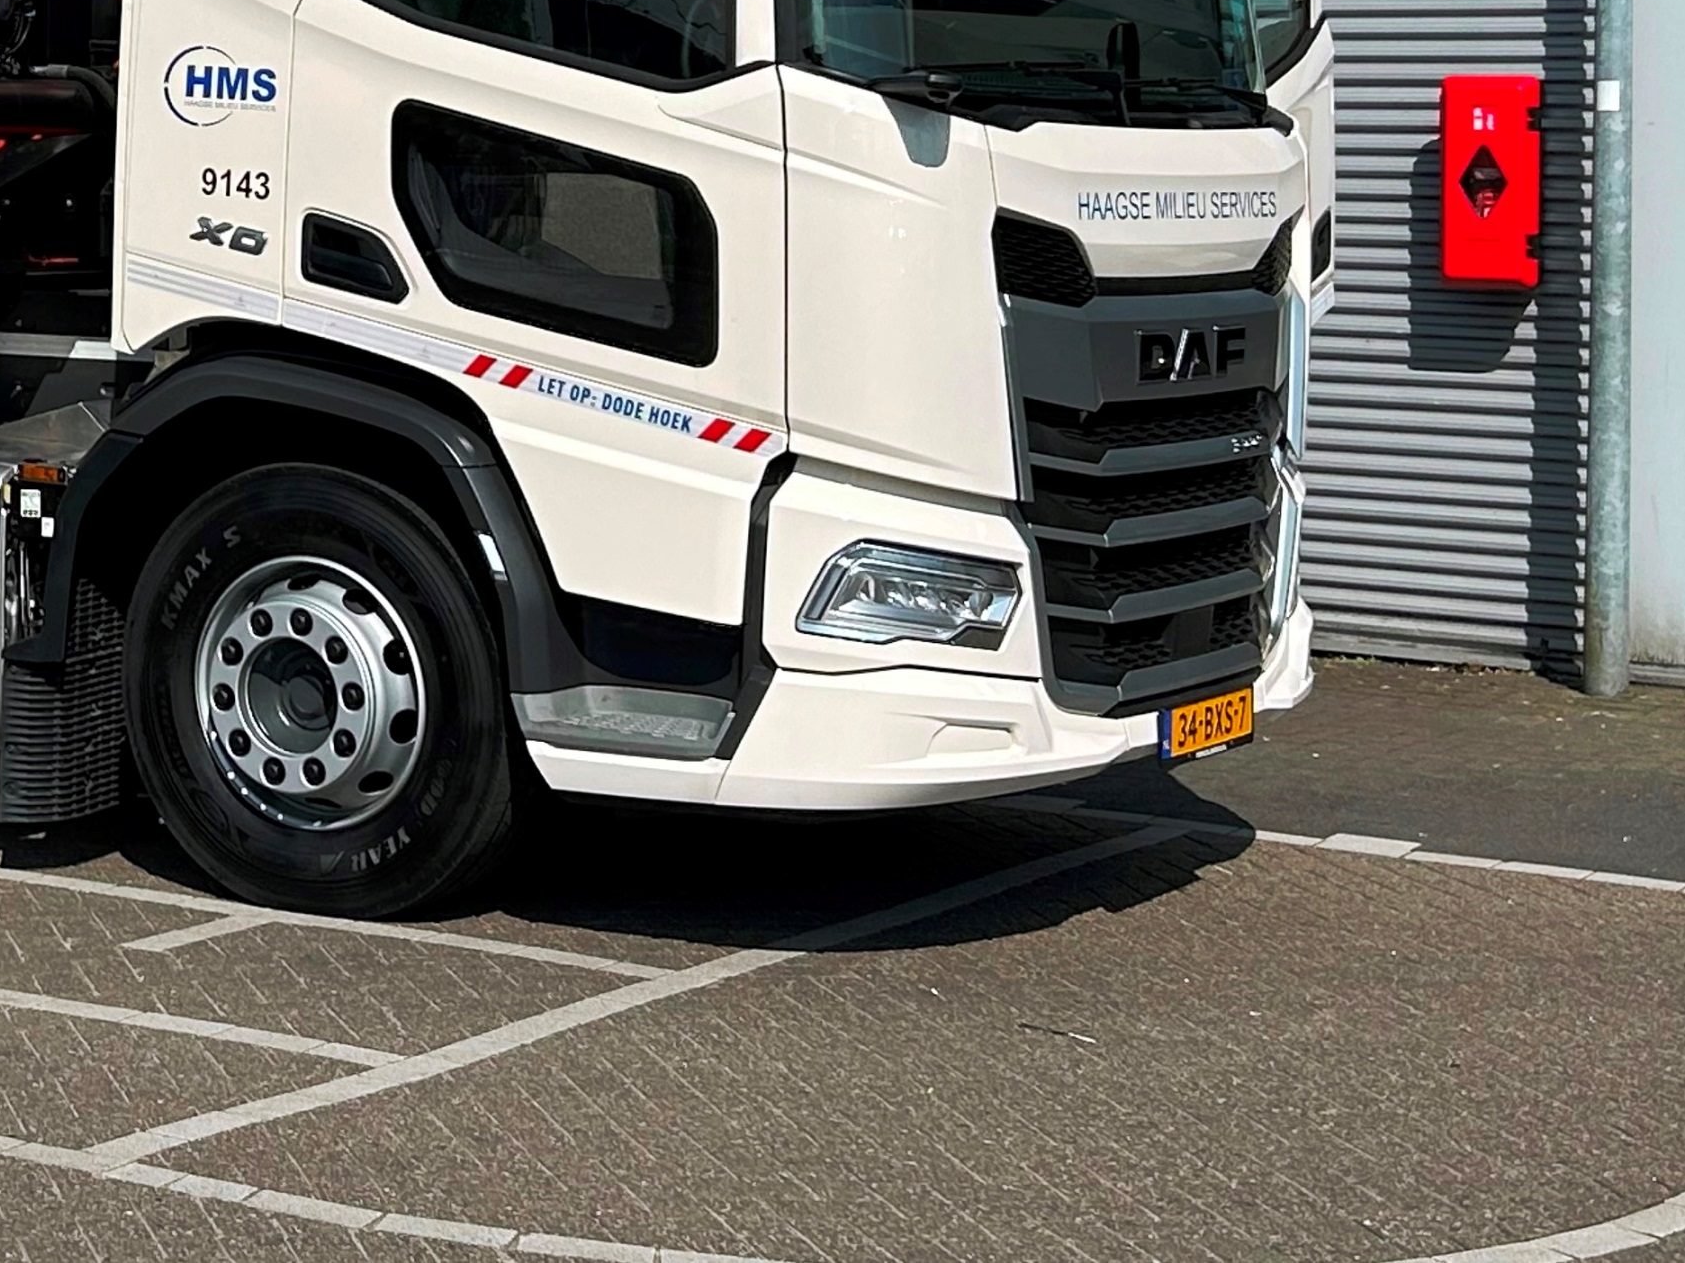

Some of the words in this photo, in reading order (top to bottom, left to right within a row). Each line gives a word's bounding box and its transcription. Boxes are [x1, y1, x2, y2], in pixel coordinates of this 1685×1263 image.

[185, 65, 277, 102] HMS
[201, 167, 271, 201] 9143
[1077, 190, 1152, 221] HAAGSE
[1155, 190, 1207, 220] MILIEU
[1209, 190, 1278, 219] SERVICES
[1133, 324, 1247, 385] DAF
[537, 374, 566, 399] LET
[569, 383, 598, 408] OP:
[601, 393, 646, 421] DODE
[648, 405, 694, 434] HOEK
[159, 546, 213, 631] KMAX
[221, 523, 243, 550] S
[1177, 695, 1248, 748] 34-BXS-7
[349, 825, 412, 873] YEAR
